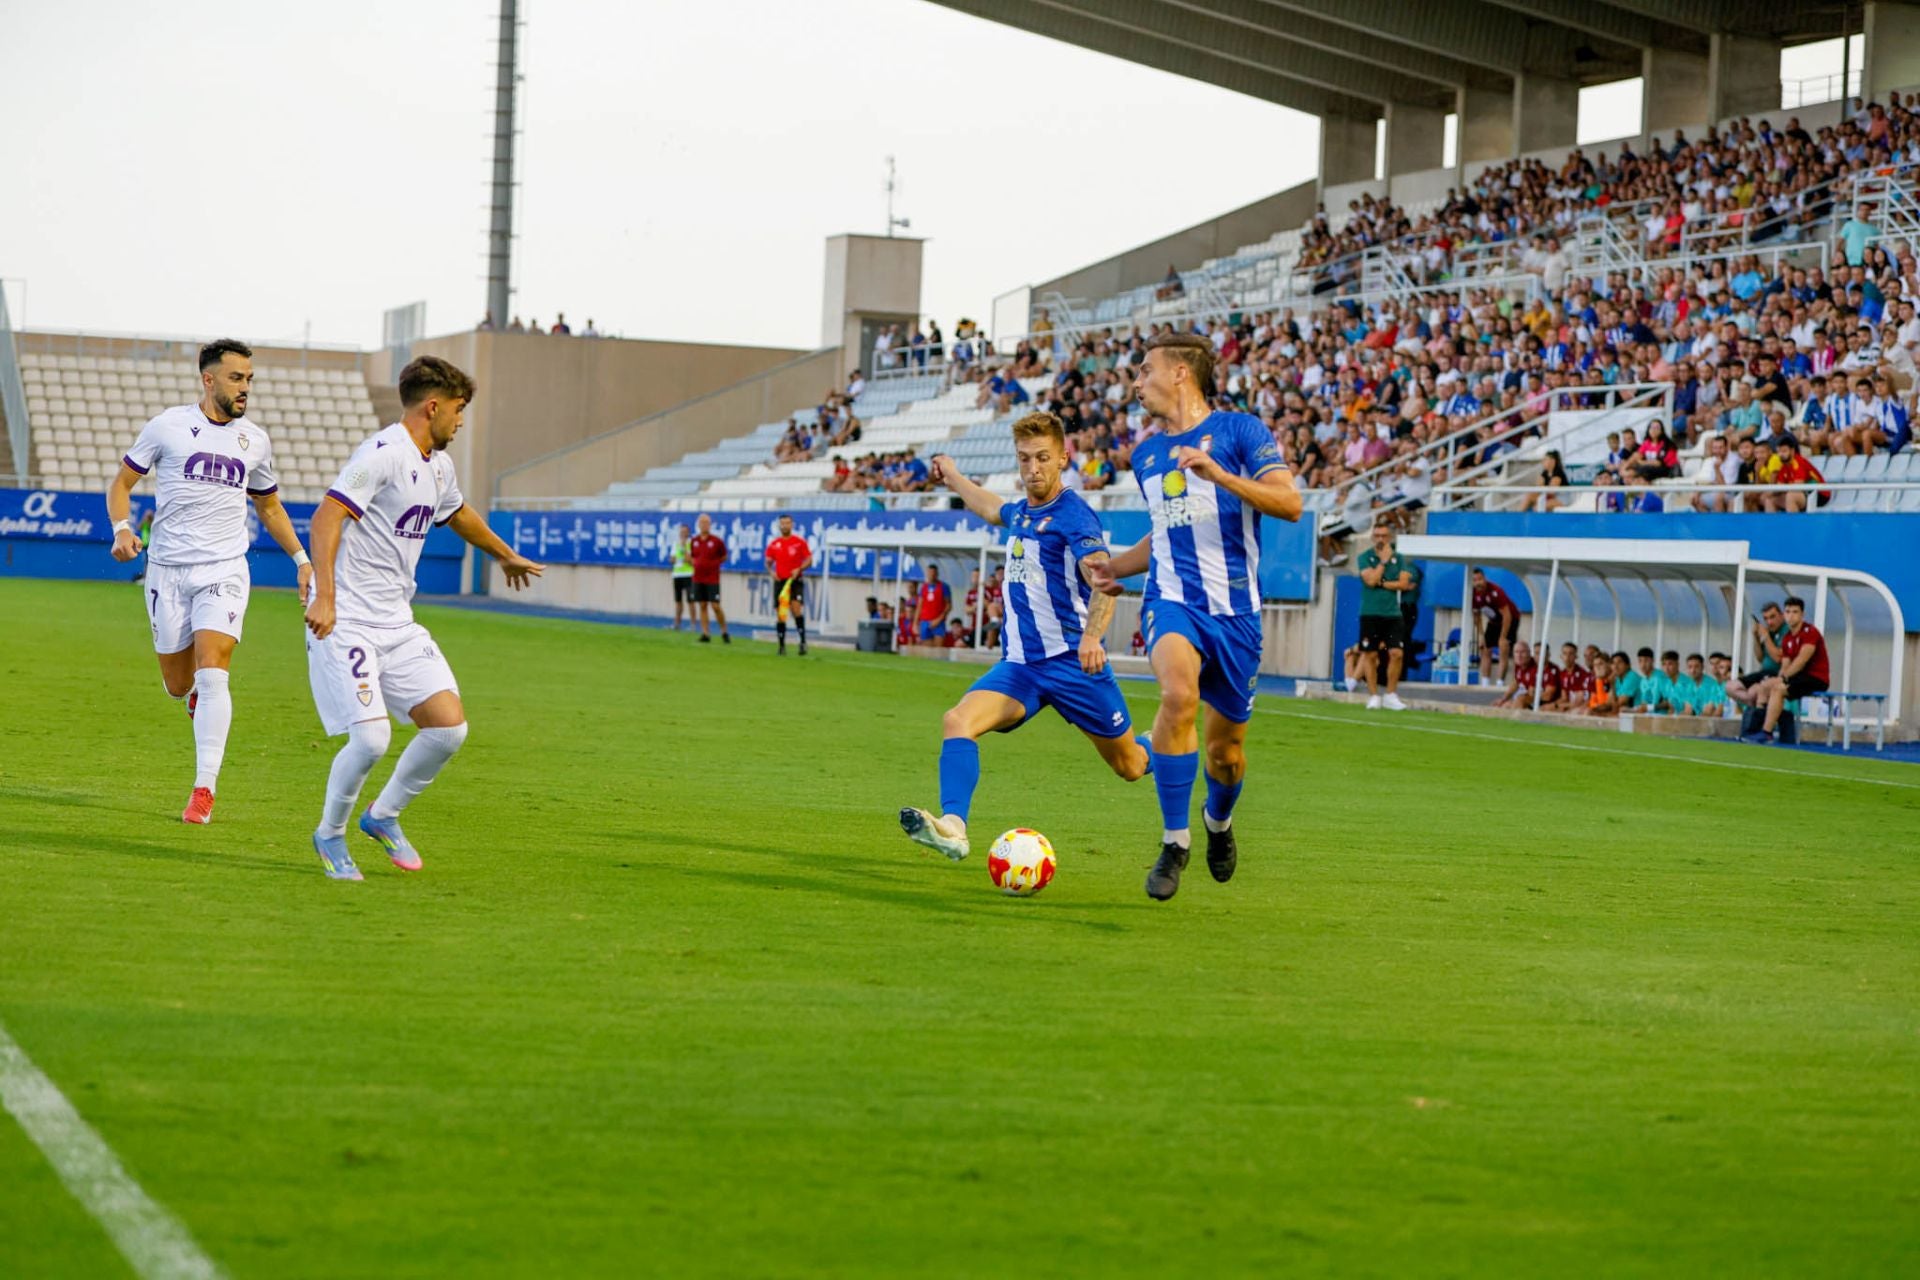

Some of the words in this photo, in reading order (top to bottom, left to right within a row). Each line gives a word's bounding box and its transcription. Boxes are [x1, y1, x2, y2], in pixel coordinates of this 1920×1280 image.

[0, 516, 39, 535] lpha
[42, 519, 92, 537] spirit
[151, 589, 159, 617] 7
[348, 647, 369, 678] 2
